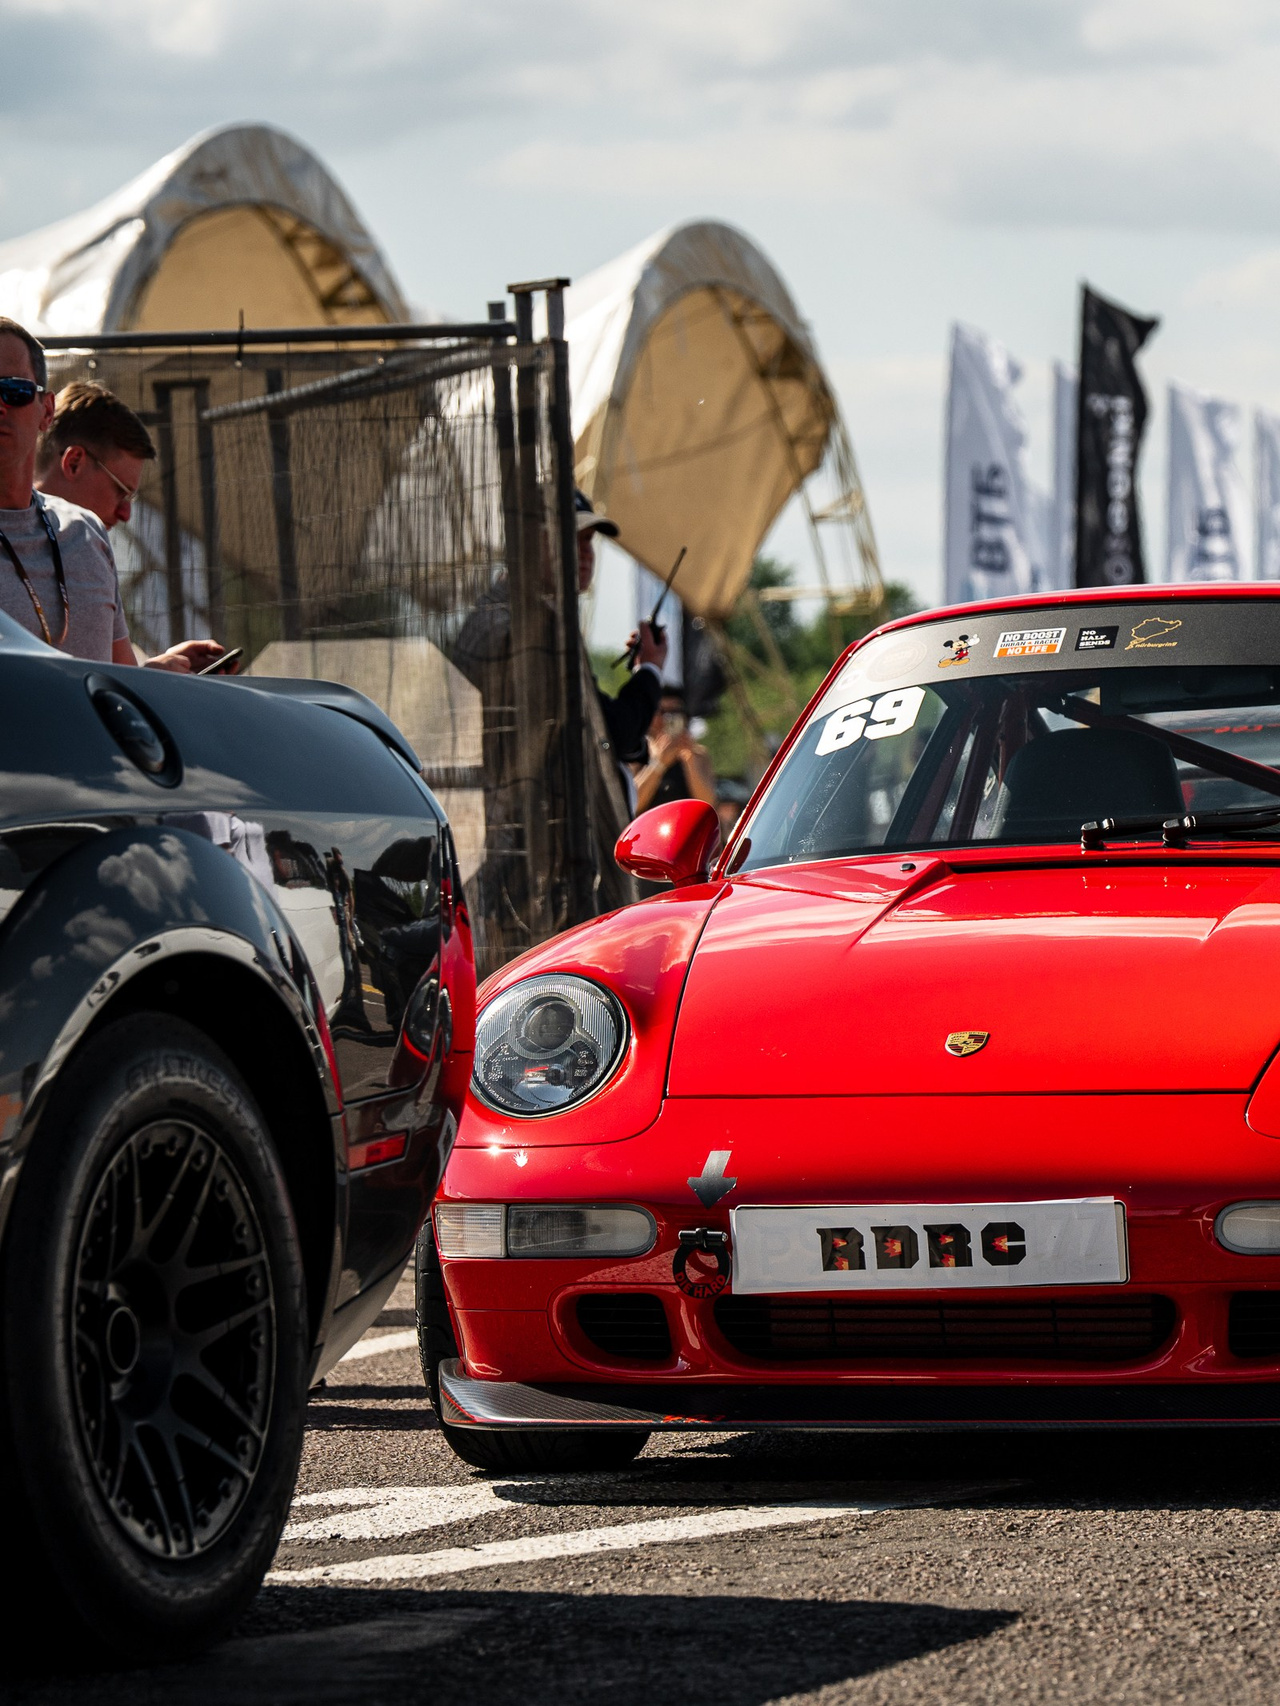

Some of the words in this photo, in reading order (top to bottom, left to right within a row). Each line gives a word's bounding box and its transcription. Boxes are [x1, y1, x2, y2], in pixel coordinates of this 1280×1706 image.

[1004, 633, 1021, 642] NO
[1023, 630, 1060, 640] BOOST
[1007, 647, 1022, 655] NO
[1025, 645, 1049, 654] LIFE
[814, 686, 927, 757] 69
[816, 1221, 1027, 1272] RDRC
[675, 1272, 693, 1294] DIE
[694, 1274, 726, 1298] HARD
